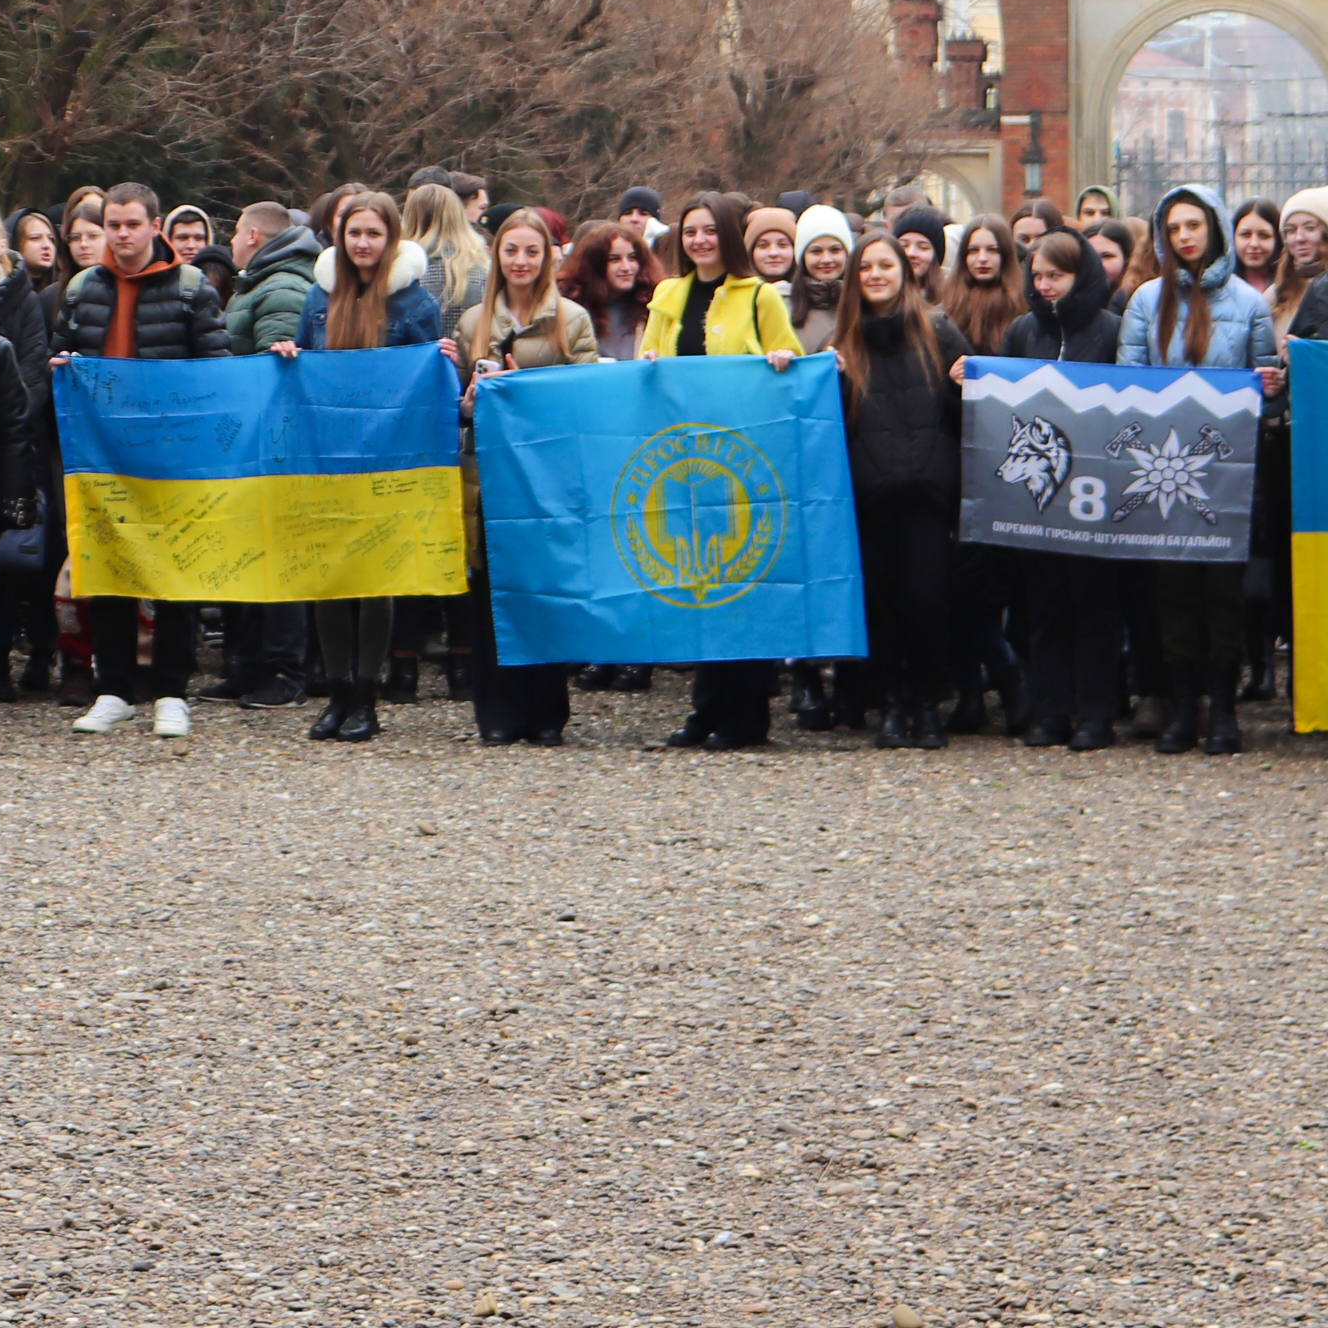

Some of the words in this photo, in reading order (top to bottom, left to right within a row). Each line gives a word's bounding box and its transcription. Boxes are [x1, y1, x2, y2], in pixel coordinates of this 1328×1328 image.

[629, 432, 756, 487] ПРОСВІТА
[1068, 475, 1106, 522] 8
[992, 520, 1043, 536] ОКРЕМИЙ
[1045, 527, 1165, 546] ГІРСЬКО-ШТУРМОВИЙ
[1167, 535, 1231, 548] БАТАЛЬЙОН
